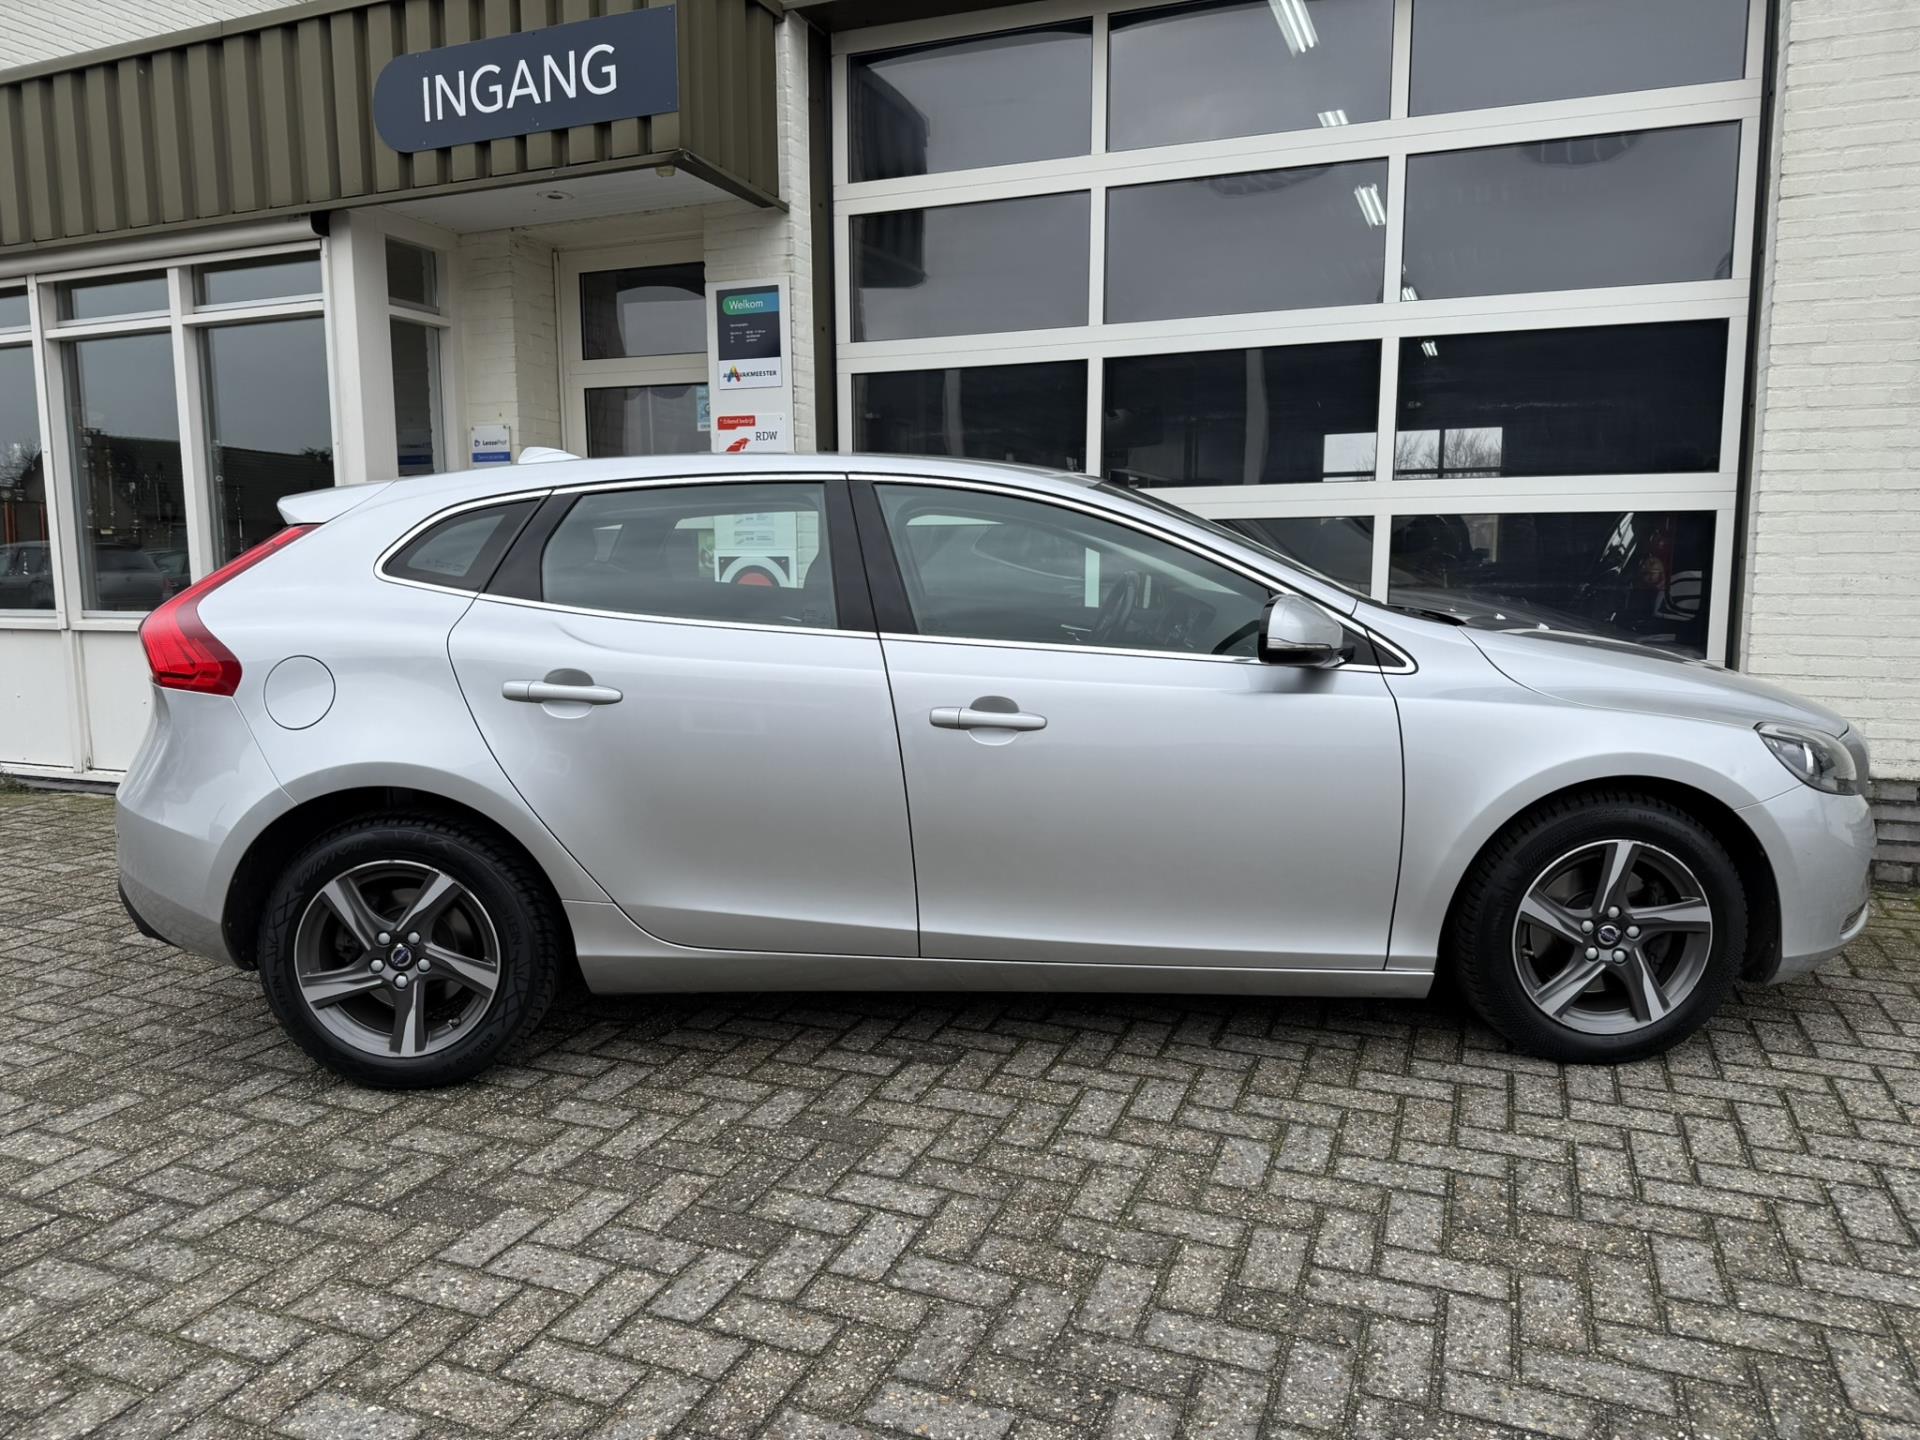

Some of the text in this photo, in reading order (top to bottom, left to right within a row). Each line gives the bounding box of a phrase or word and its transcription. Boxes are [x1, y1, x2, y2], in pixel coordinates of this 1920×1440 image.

[422, 43, 617, 123] INGANG
[728, 299, 764, 310] Welkom
[723, 370, 777, 378] AVAKMEESTER
[755, 430, 778, 441] RDW
